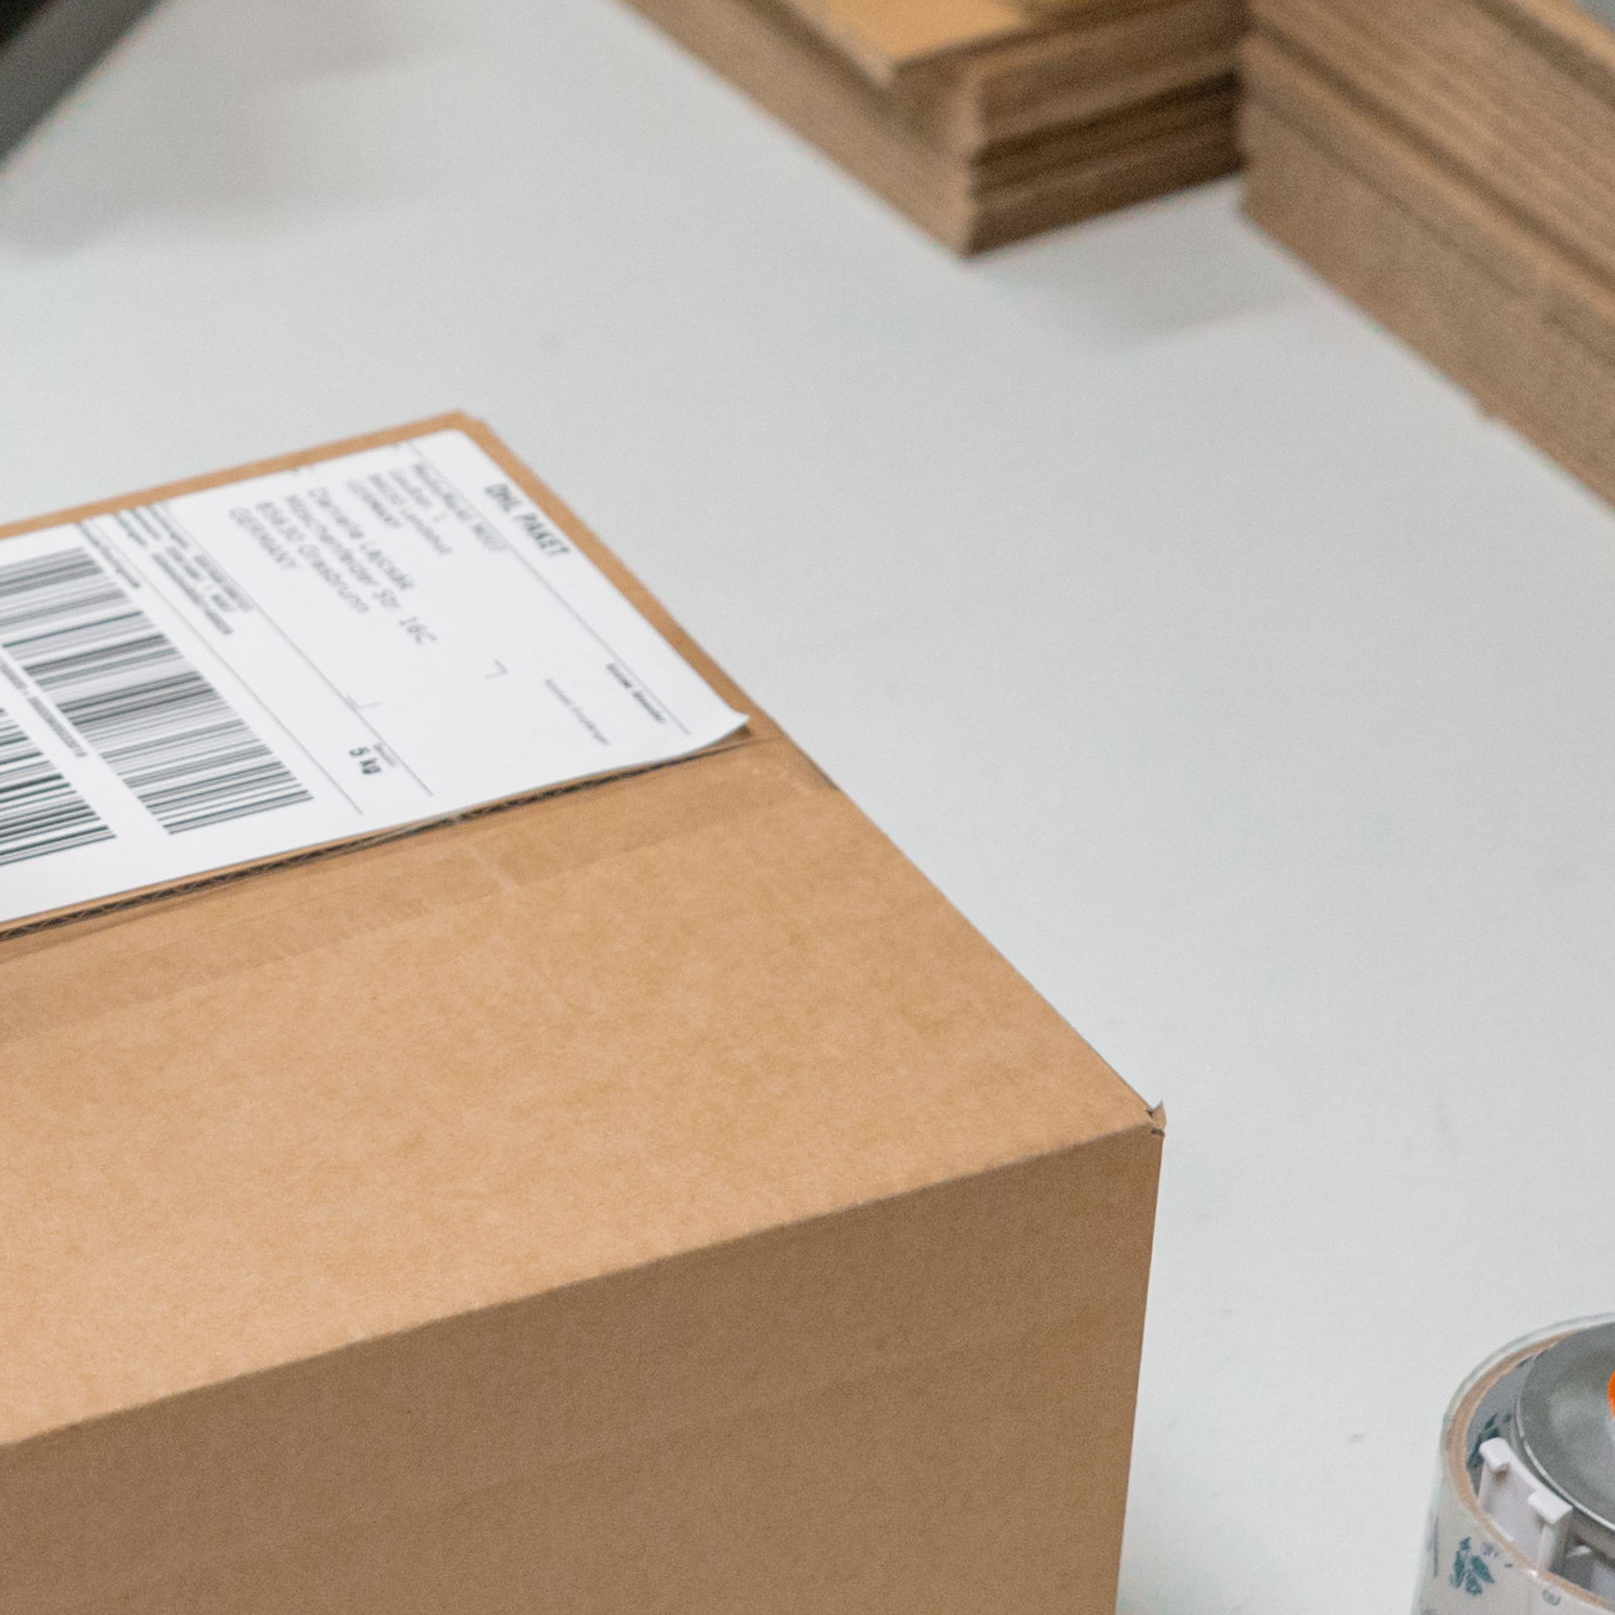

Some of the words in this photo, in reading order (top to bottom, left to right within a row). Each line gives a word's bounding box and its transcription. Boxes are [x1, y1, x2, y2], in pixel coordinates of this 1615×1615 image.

[484, 483, 520, 512] DHL
[519, 513, 569, 554] PAKET
[348, 746, 370, 757] 5
[359, 757, 381, 774] kg
